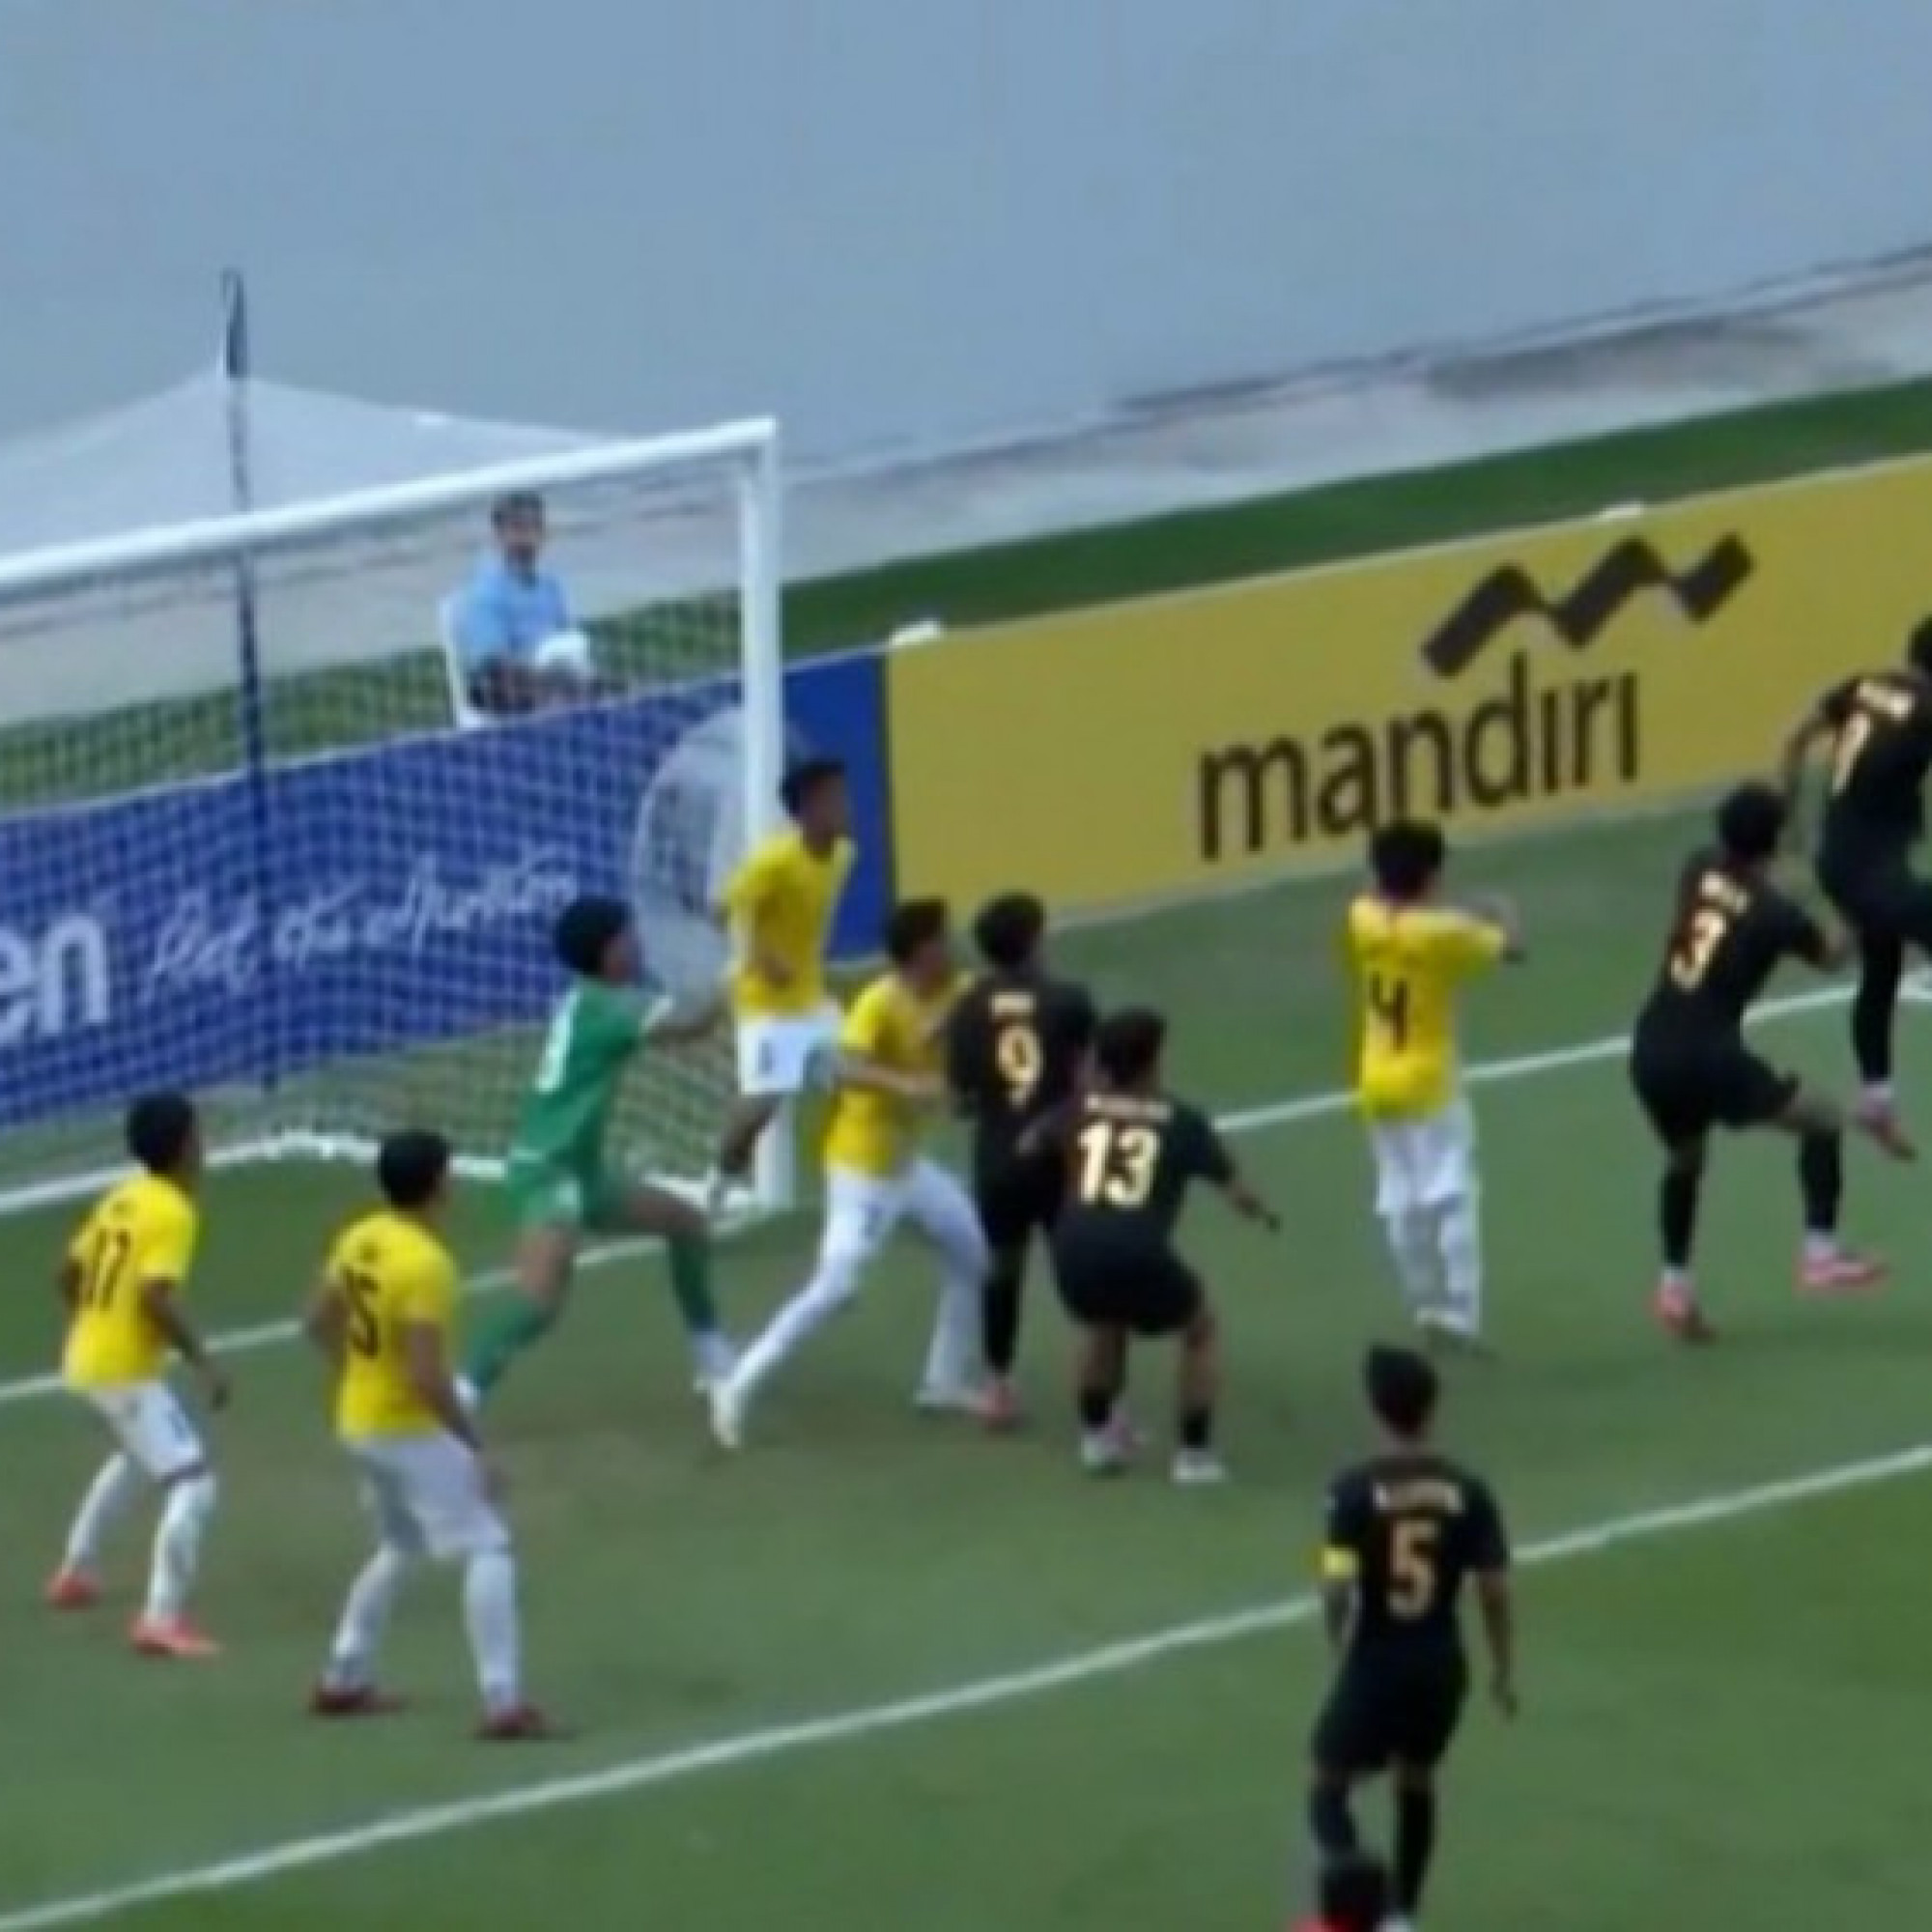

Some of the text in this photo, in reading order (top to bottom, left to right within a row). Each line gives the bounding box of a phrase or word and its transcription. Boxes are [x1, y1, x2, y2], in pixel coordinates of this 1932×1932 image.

[1199, 648, 1640, 862] mandiri
[1369, 969, 1411, 1053] 4
[996, 1022, 1043, 1108] 9
[1077, 1119, 1160, 1210] 13
[1388, 1520, 1440, 1619] 5
